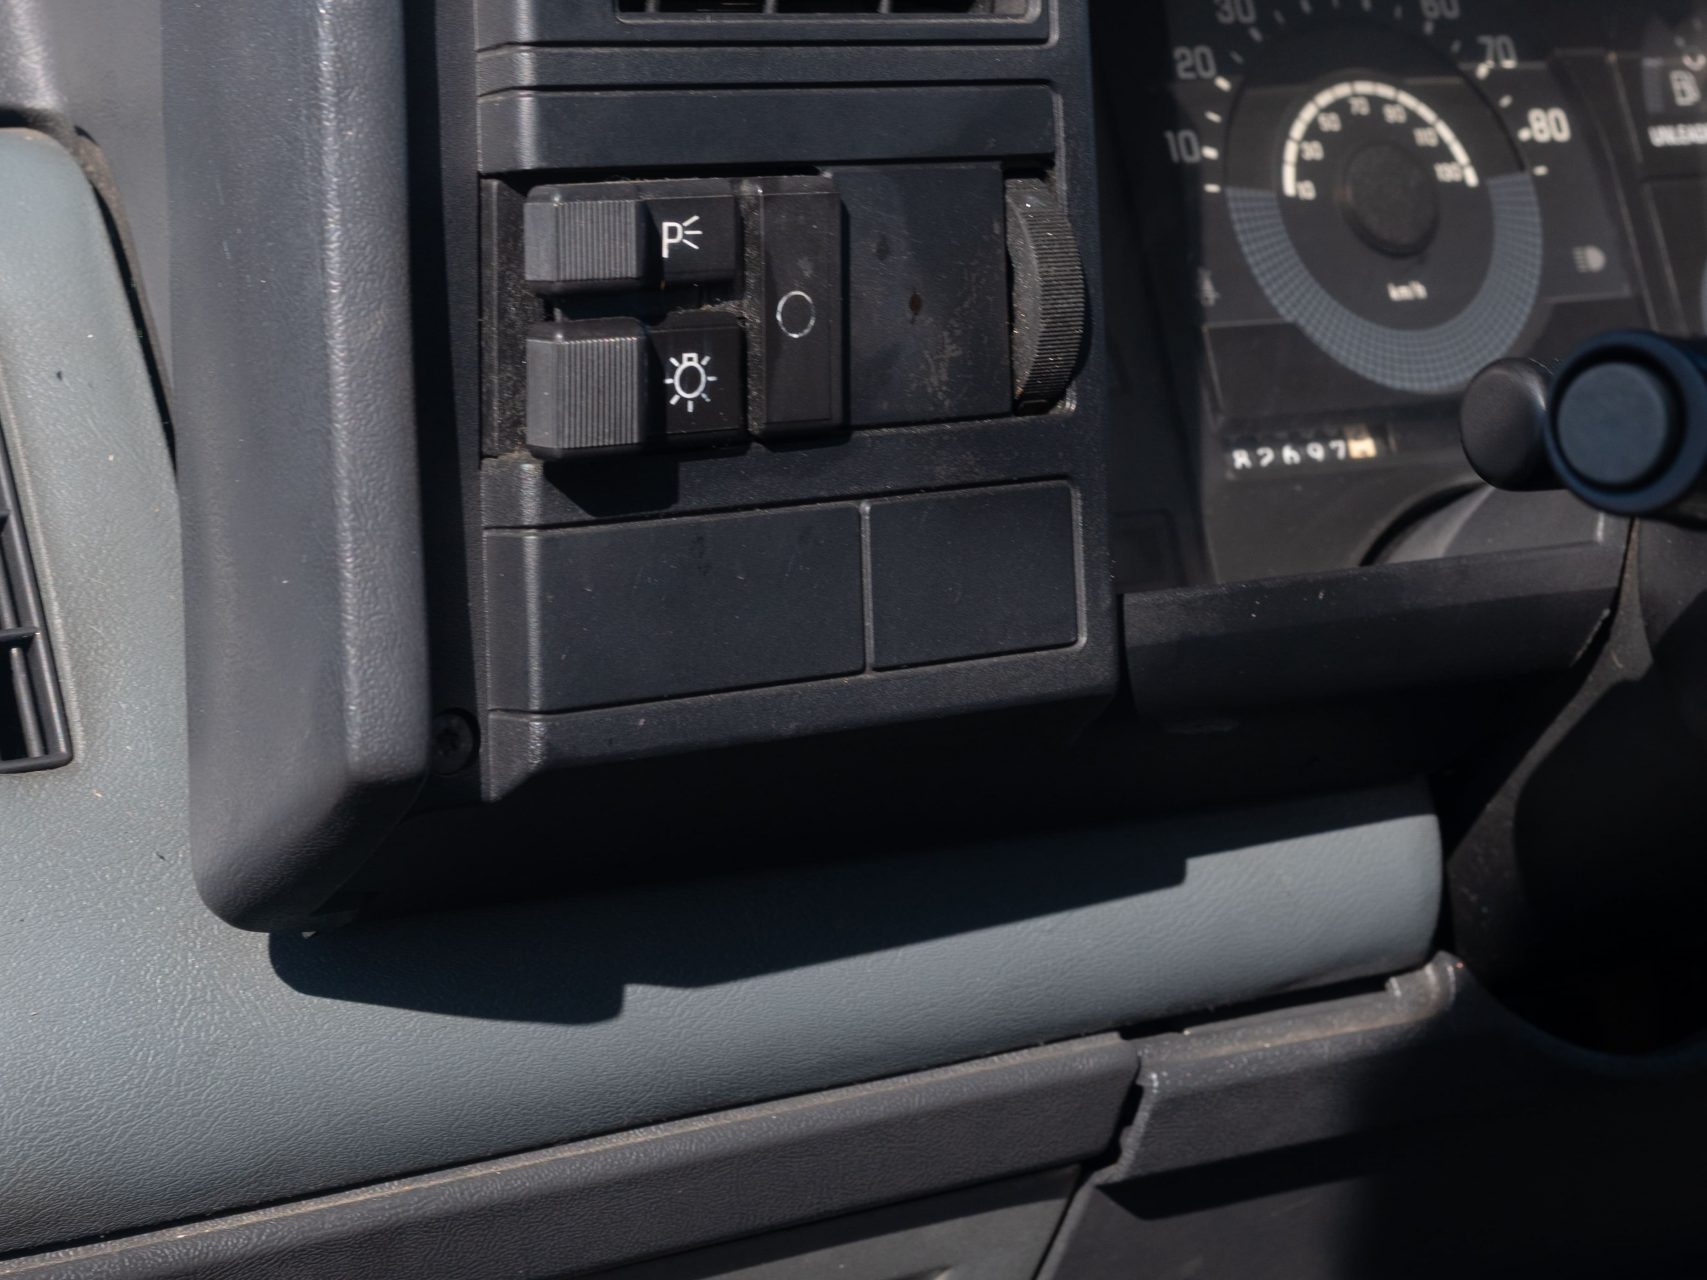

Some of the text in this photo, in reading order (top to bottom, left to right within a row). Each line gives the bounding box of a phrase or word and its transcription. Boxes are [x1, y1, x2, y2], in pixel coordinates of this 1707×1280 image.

[1173, 45, 1217, 79] 20
[1476, 35, 1518, 69] 70
[1528, 107, 1571, 142] 80
[1164, 129, 1201, 163] 10
